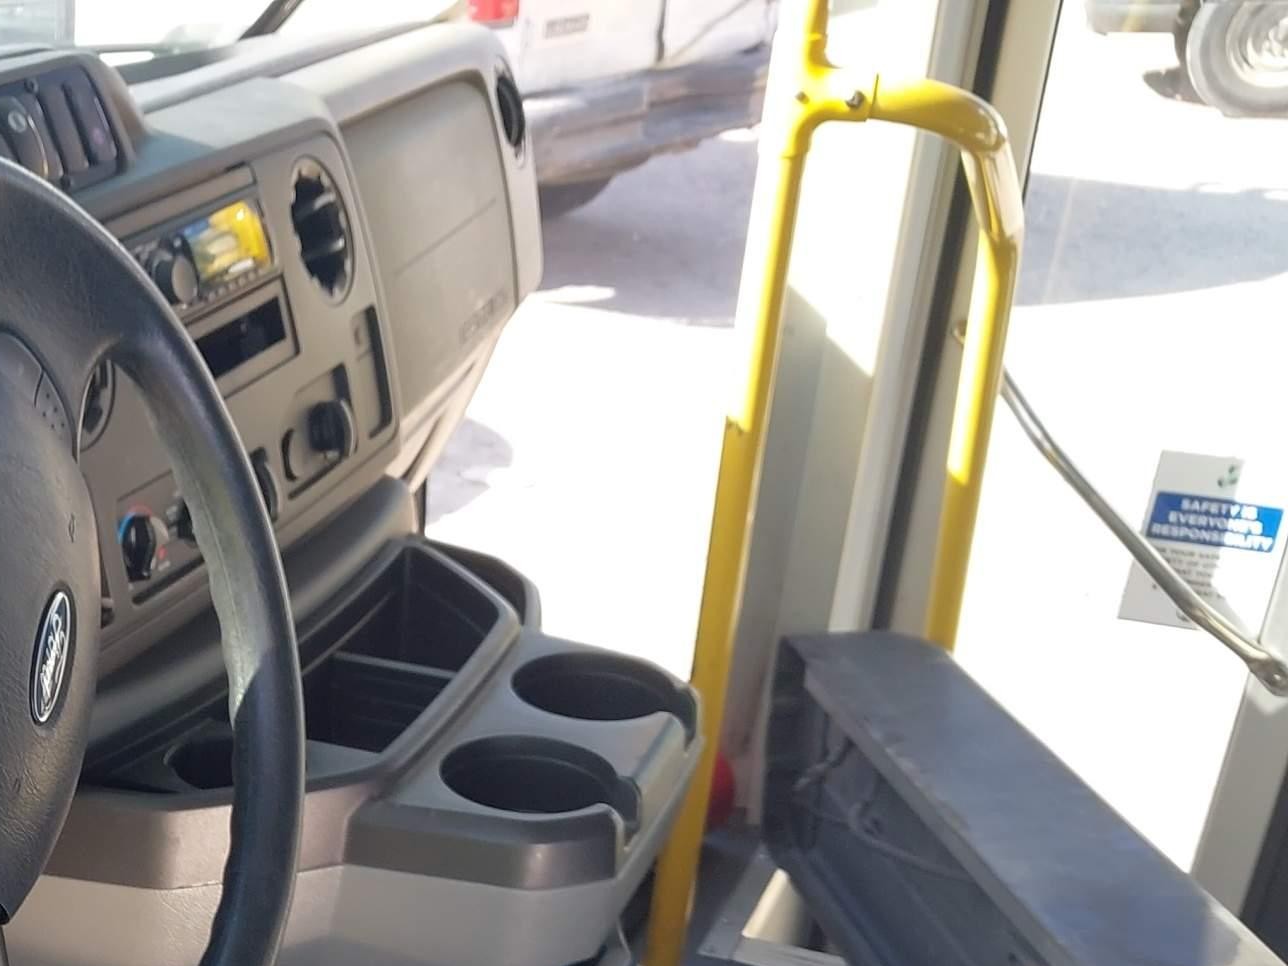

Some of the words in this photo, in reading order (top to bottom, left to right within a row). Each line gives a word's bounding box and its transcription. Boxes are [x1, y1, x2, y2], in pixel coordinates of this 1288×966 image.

[1181, 498, 1241, 518] SAFETY
[1150, 521, 1274, 551] RESPONSILITY
[1168, 510, 1264, 535] EVERYO
[39, 612, 67, 714] Ford
